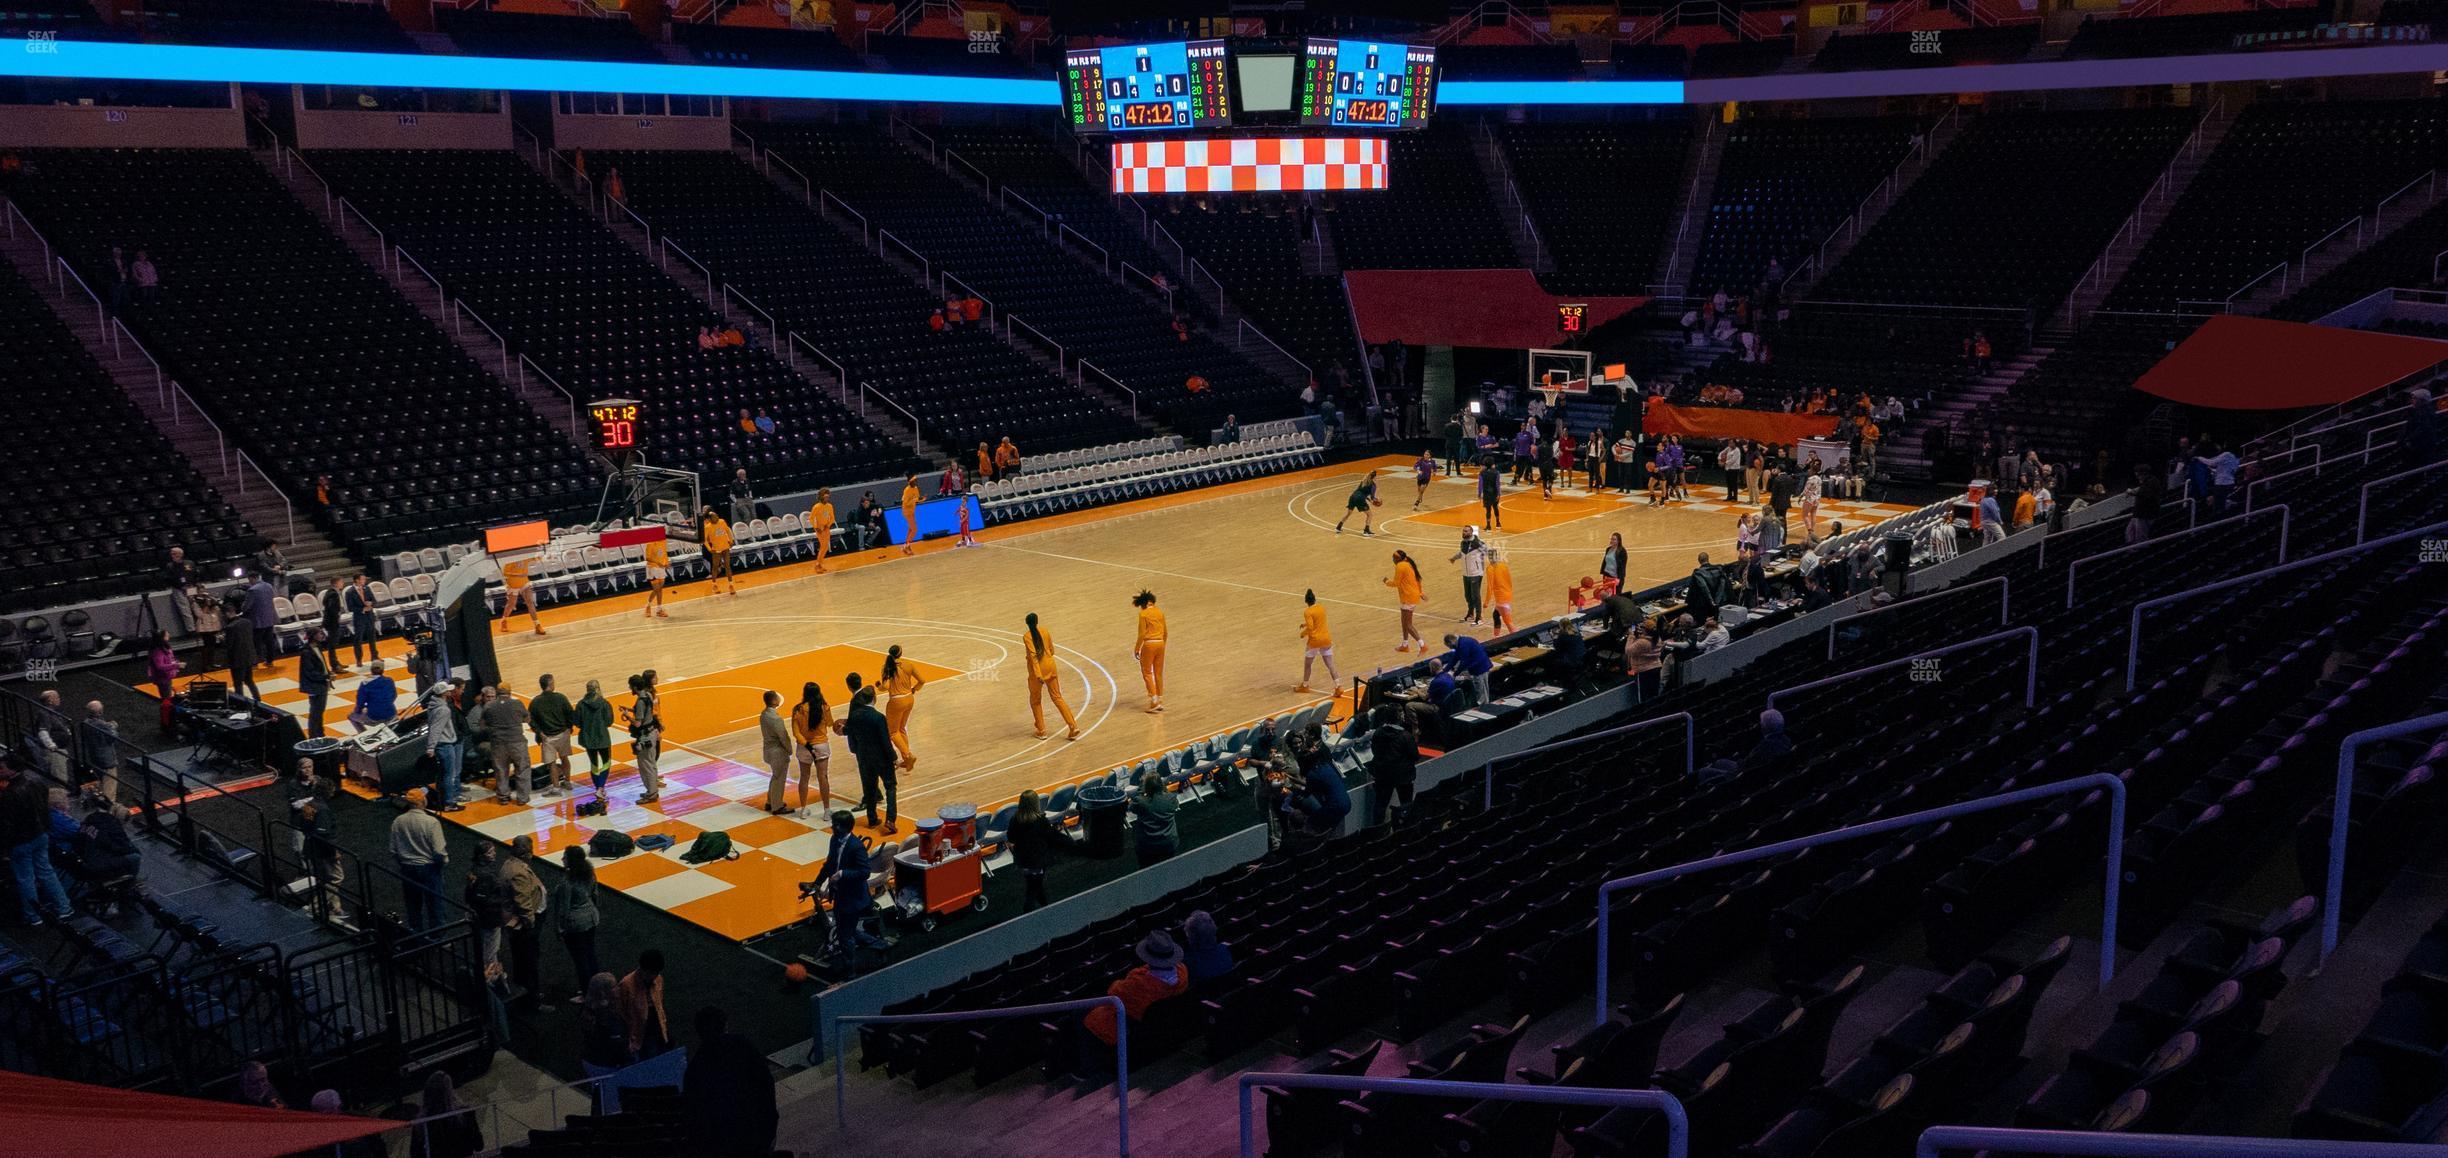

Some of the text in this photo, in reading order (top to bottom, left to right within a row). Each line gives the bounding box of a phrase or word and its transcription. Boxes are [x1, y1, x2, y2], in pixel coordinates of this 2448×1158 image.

[1142, 58, 1147, 71] 1
[1192, 61, 1222, 71] 3 0 0
[1307, 60, 1316, 68] 00
[1329, 60, 1334, 69] 9
[1370, 56, 1374, 68] 1
[1070, 71, 1079, 79] 00
[1094, 69, 1099, 77] 9
[1408, 65, 1430, 75] 3 0 0
[1192, 72, 1223, 83] 11 0 7
[1318, 71, 1322, 79] 3
[1327, 72, 1335, 81] 17
[1084, 81, 1089, 89] 3
[1094, 80, 1102, 89] 17
[1173, 78, 1180, 93] 0
[1343, 76, 1349, 90] 0
[1391, 79, 1397, 92] 0
[1406, 77, 1429, 86] 11 0 7
[1113, 82, 1120, 96] 0
[1131, 87, 1137, 97] 4
[1156, 86, 1162, 95] 4
[1192, 84, 1224, 95] 20 2 7
[1306, 84, 1314, 92] 13
[1327, 84, 1332, 93] 8
[1357, 84, 1362, 93] 4
[1377, 85, 1382, 93] 4
[1404, 88, 1412, 96] 20
[1416, 88, 1420, 96] 2
[1073, 93, 1081, 101] 13
[1096, 91, 1102, 100] 8
[1193, 98, 1202, 106] 21
[1220, 96, 1225, 105] 2
[1304, 95, 1312, 104] 23
[1325, 96, 1333, 104] 10
[1073, 104, 1083, 112] 23
[1096, 103, 1105, 112] 10
[1403, 99, 1410, 107] 21
[1422, 100, 1427, 108] 2
[1126, 104, 1172, 124] 47:12
[1194, 108, 1226, 118] 24 0 0
[1303, 106, 1330, 116] 33 0 0
[1337, 111, 1342, 120] 0
[1348, 101, 1386, 120] 47:12
[1402, 110, 1426, 119] 24 0 0
[105, 111, 127, 122] 120
[400, 115, 417, 126] 121
[1075, 114, 1104, 123] 33 0 0
[1113, 116, 1120, 126] 0
[1179, 113, 1186, 123] 0
[1390, 112, 1395, 122] 0
[1560, 307, 1582, 317] 47:12
[1564, 316, 1578, 330] 30
[594, 406, 636, 420] 47:12
[603, 422, 632, 446] 30
